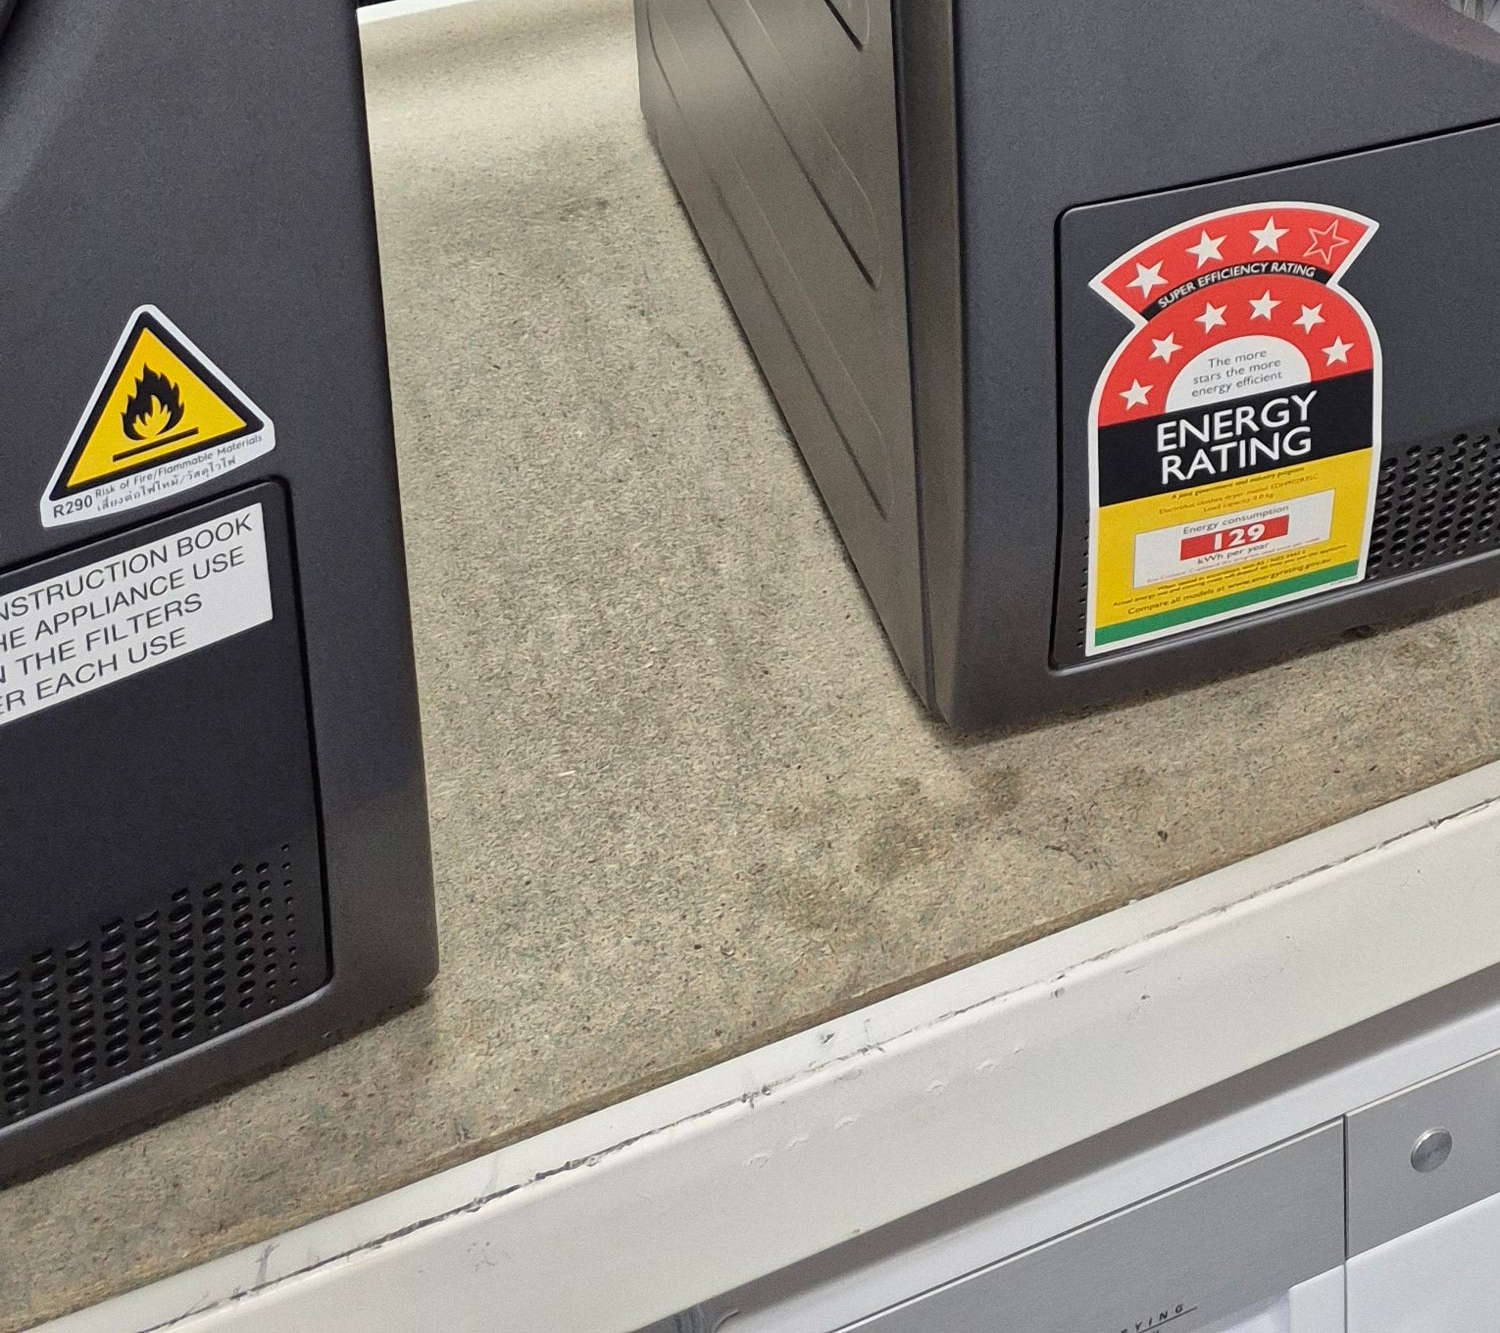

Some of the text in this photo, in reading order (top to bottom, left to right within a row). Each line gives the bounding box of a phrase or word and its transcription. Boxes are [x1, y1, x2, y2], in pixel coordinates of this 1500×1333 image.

[1158, 262, 1316, 308] SUPER EFFICIENCY RATING
[1193, 359, 1280, 384] stars the more
[1208, 349, 1266, 368] The more
[1191, 369, 1282, 400] energy efficient
[1157, 390, 1317, 452] ENERGY
[95, 485, 115, 499] Risk
[120, 480, 130, 491] of
[217, 435, 263, 455] Materials
[1162, 426, 1311, 484] RATING
[53, 495, 93, 518] R290
[1183, 504, 1289, 535] Energy consumption
[1198, 553, 1223, 564] kWh
[1226, 549, 1242, 558] per
[1248, 543, 1268, 553] year
[1213, 524, 1266, 551] 129
[0, 512, 252, 622] NSTRUCTION BOOK
[0, 545, 245, 653] HE APPLIANCE USE
[16, 590, 202, 679] THE FILTERS
[36, 652, 117, 702] EACH
[127, 626, 186, 666] USE
